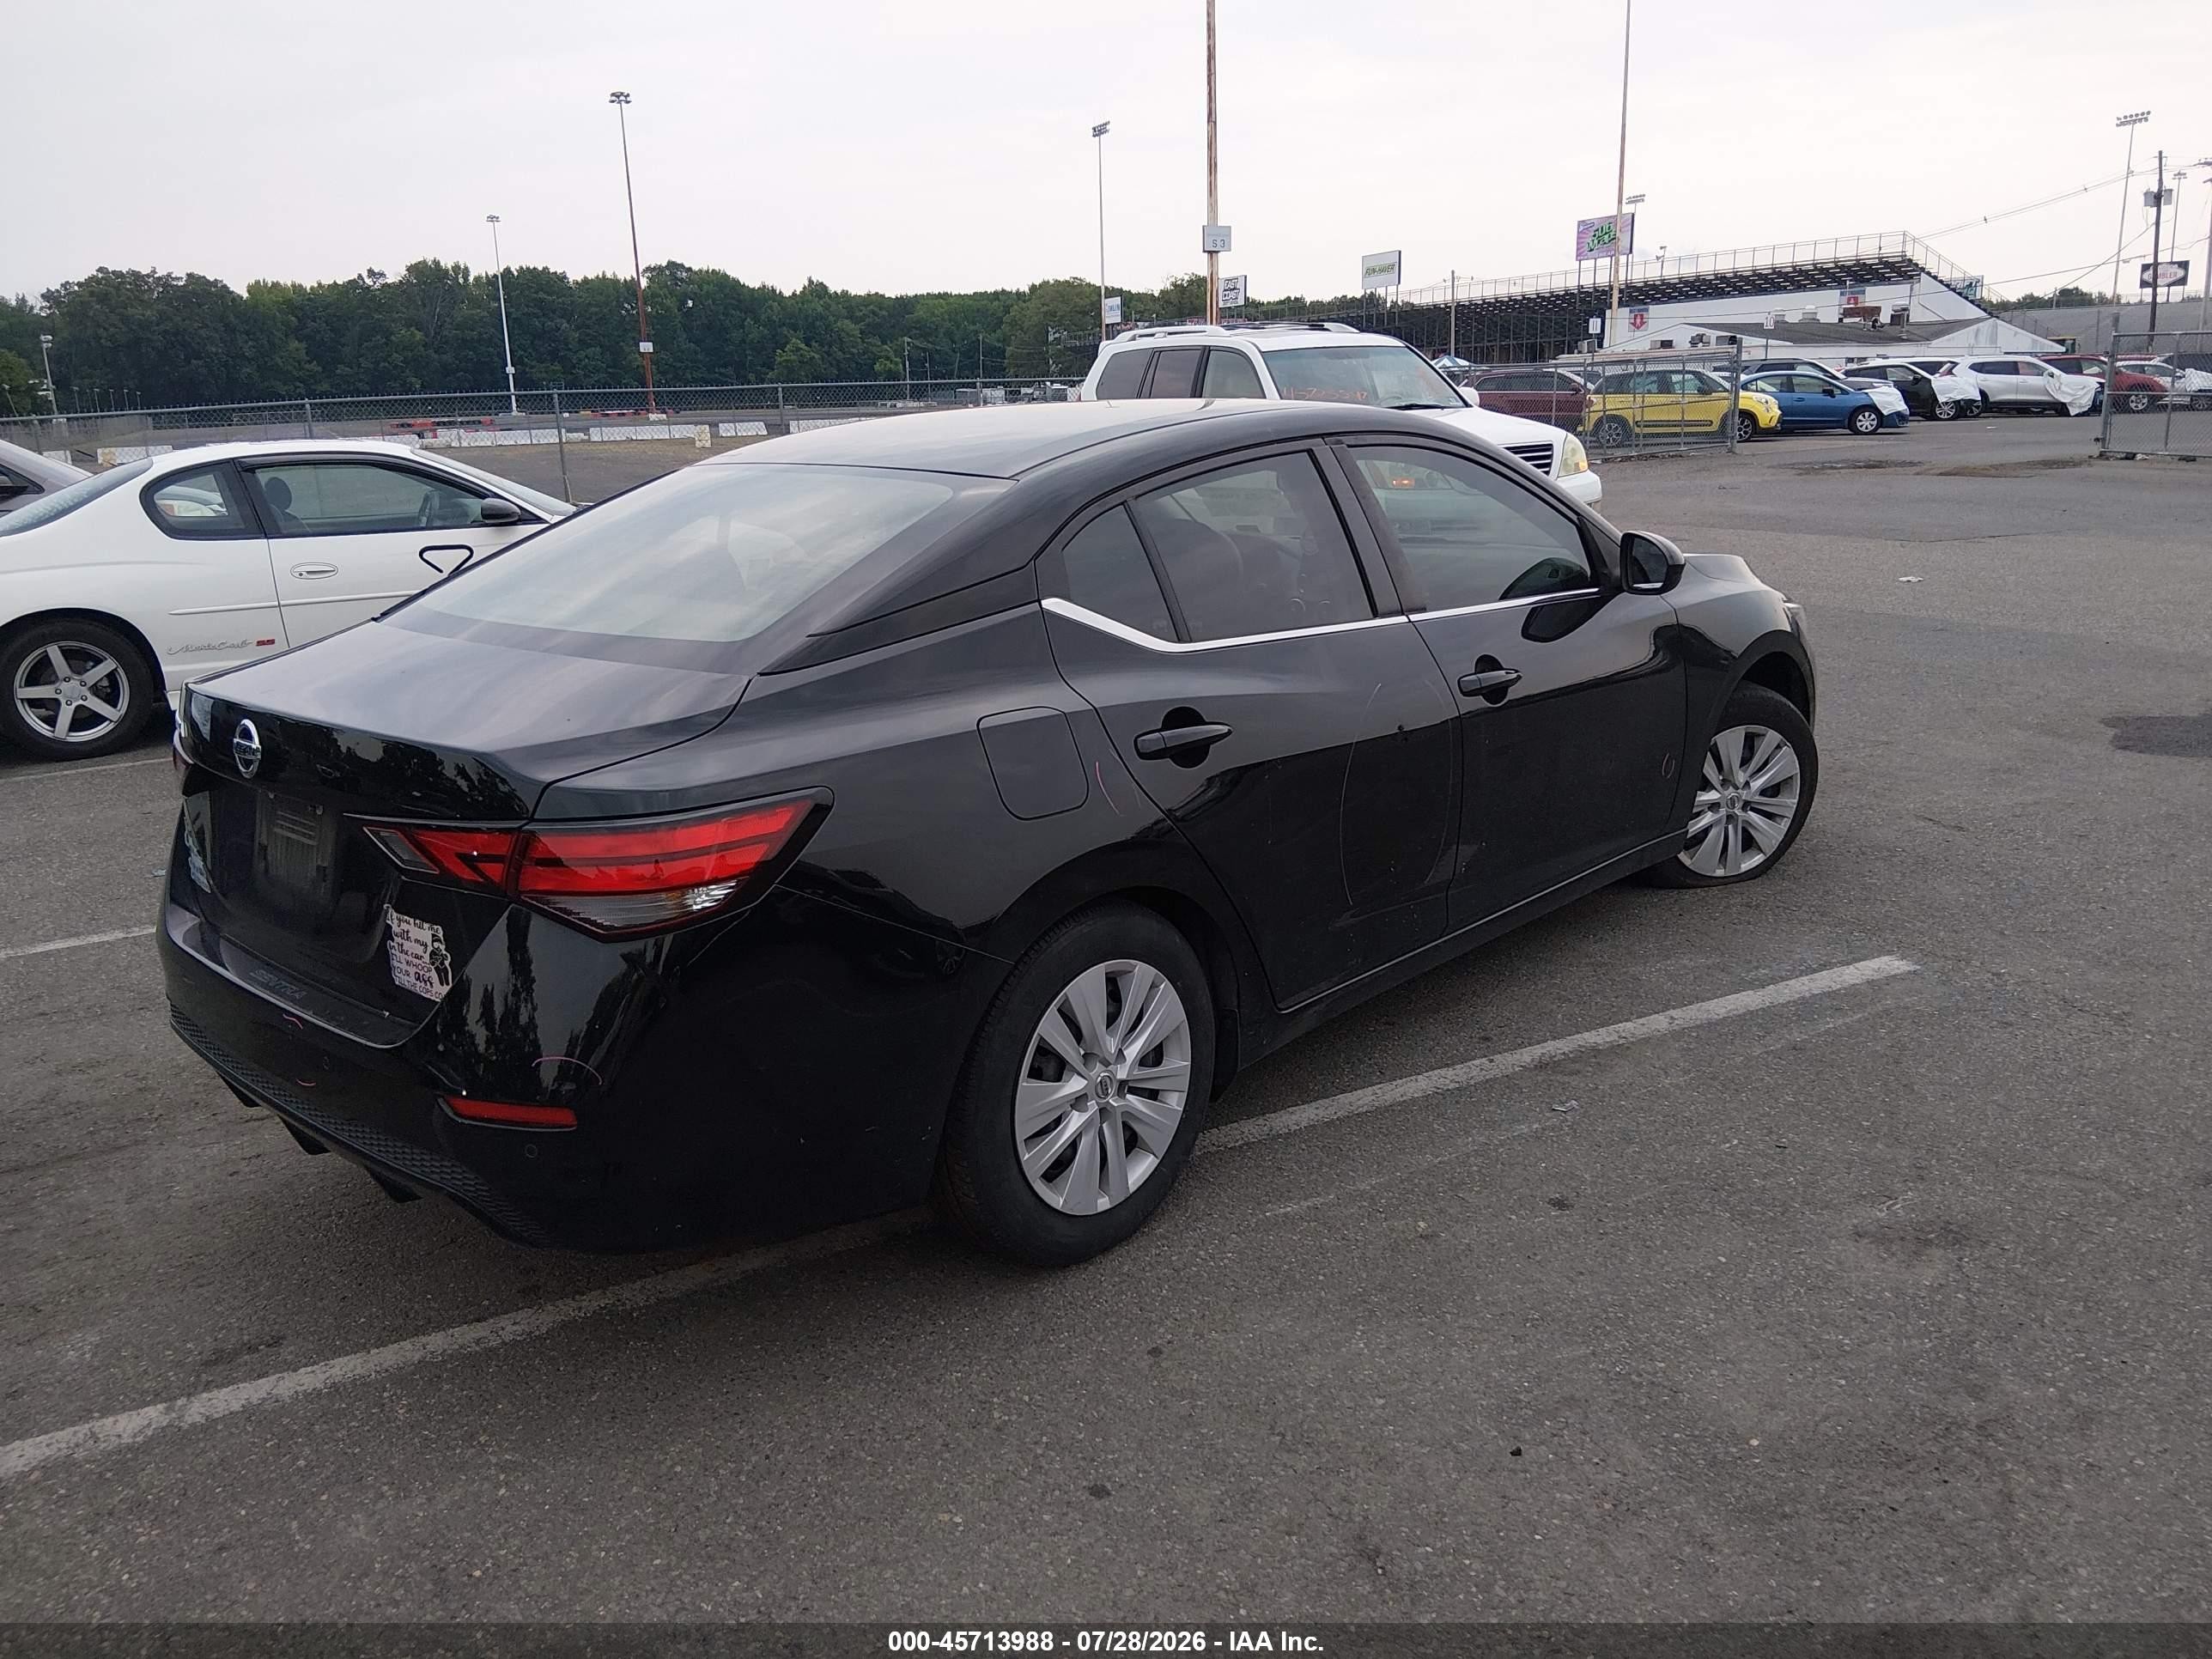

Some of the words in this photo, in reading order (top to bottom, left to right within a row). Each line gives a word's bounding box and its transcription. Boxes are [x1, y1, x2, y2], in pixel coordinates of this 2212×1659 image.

[1223, 278, 1238, 290] EAST
[1222, 289, 1240, 301] COAST
[1765, 316, 1775, 327] 10
[393, 928, 413, 944] with
[414, 938, 428, 955] my
[397, 942, 410, 957] the
